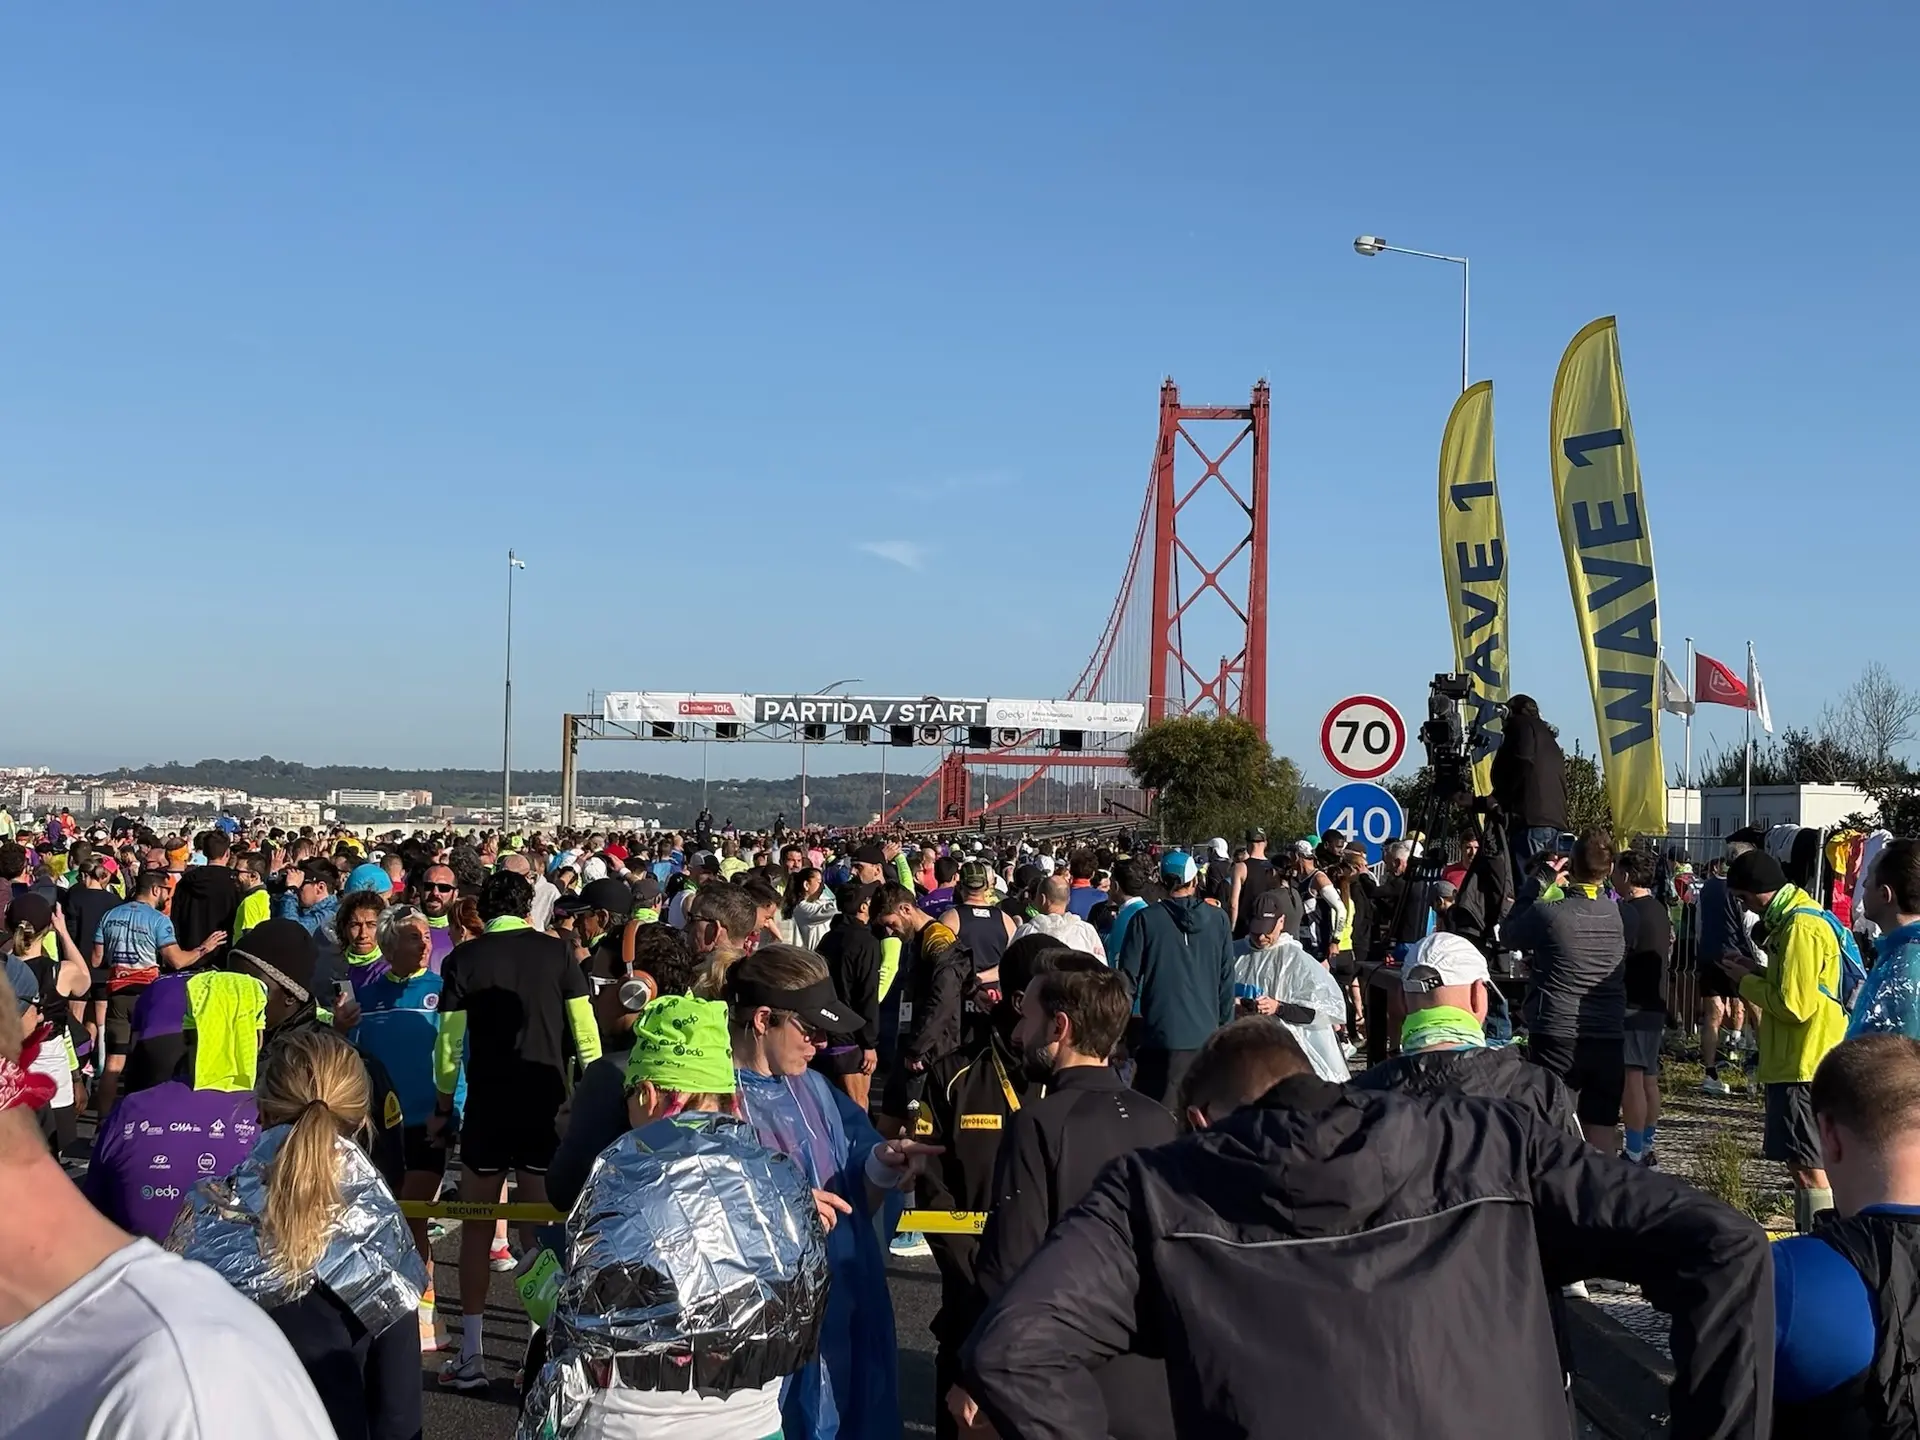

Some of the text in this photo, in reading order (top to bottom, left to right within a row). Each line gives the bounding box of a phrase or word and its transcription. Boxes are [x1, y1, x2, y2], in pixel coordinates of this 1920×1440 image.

[1563, 428, 1657, 756] WAVE 1
[1450, 481, 1503, 765] WAVE 1
[713, 704, 731, 713] 10k
[764, 702, 877, 723] PARTIDA
[899, 704, 982, 723] START
[1007, 710, 1025, 719] edp
[1336, 721, 1391, 755] 70
[1328, 807, 1392, 845] 40
[682, 1014, 699, 1025] edp
[155, 1184, 180, 1200] edp
[446, 1206, 494, 1215] SECURITY
